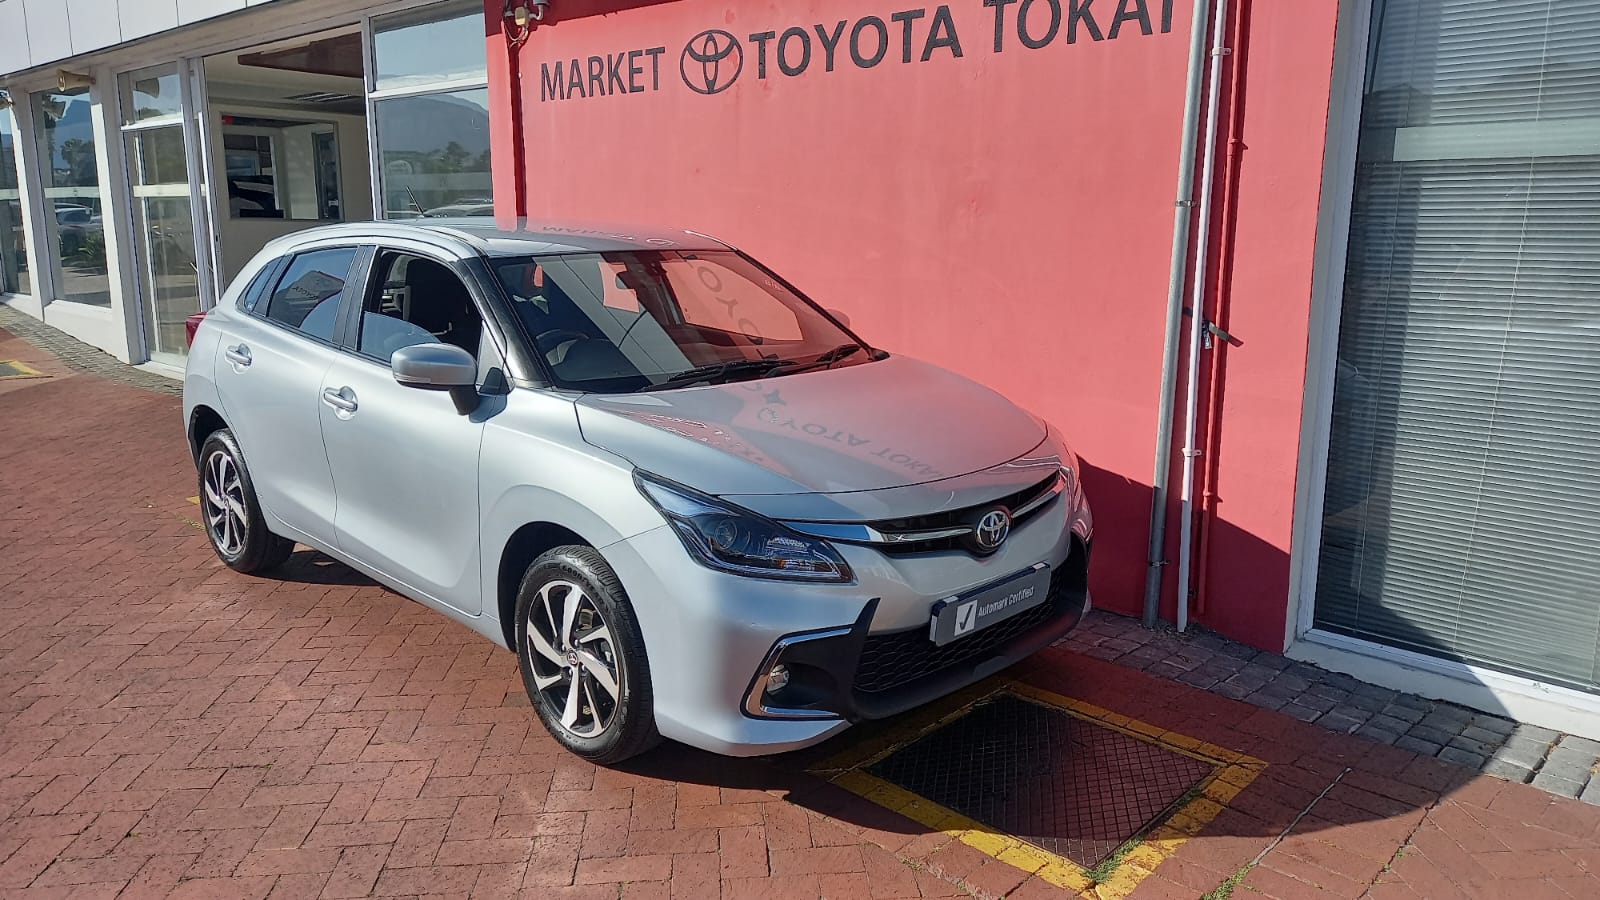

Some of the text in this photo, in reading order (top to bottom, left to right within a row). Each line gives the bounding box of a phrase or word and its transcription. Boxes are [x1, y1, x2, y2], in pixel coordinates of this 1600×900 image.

[540, 0, 1173, 102] MARKET TOYOTA TOKAI
[978, 585, 1034, 617] Automark Certified
